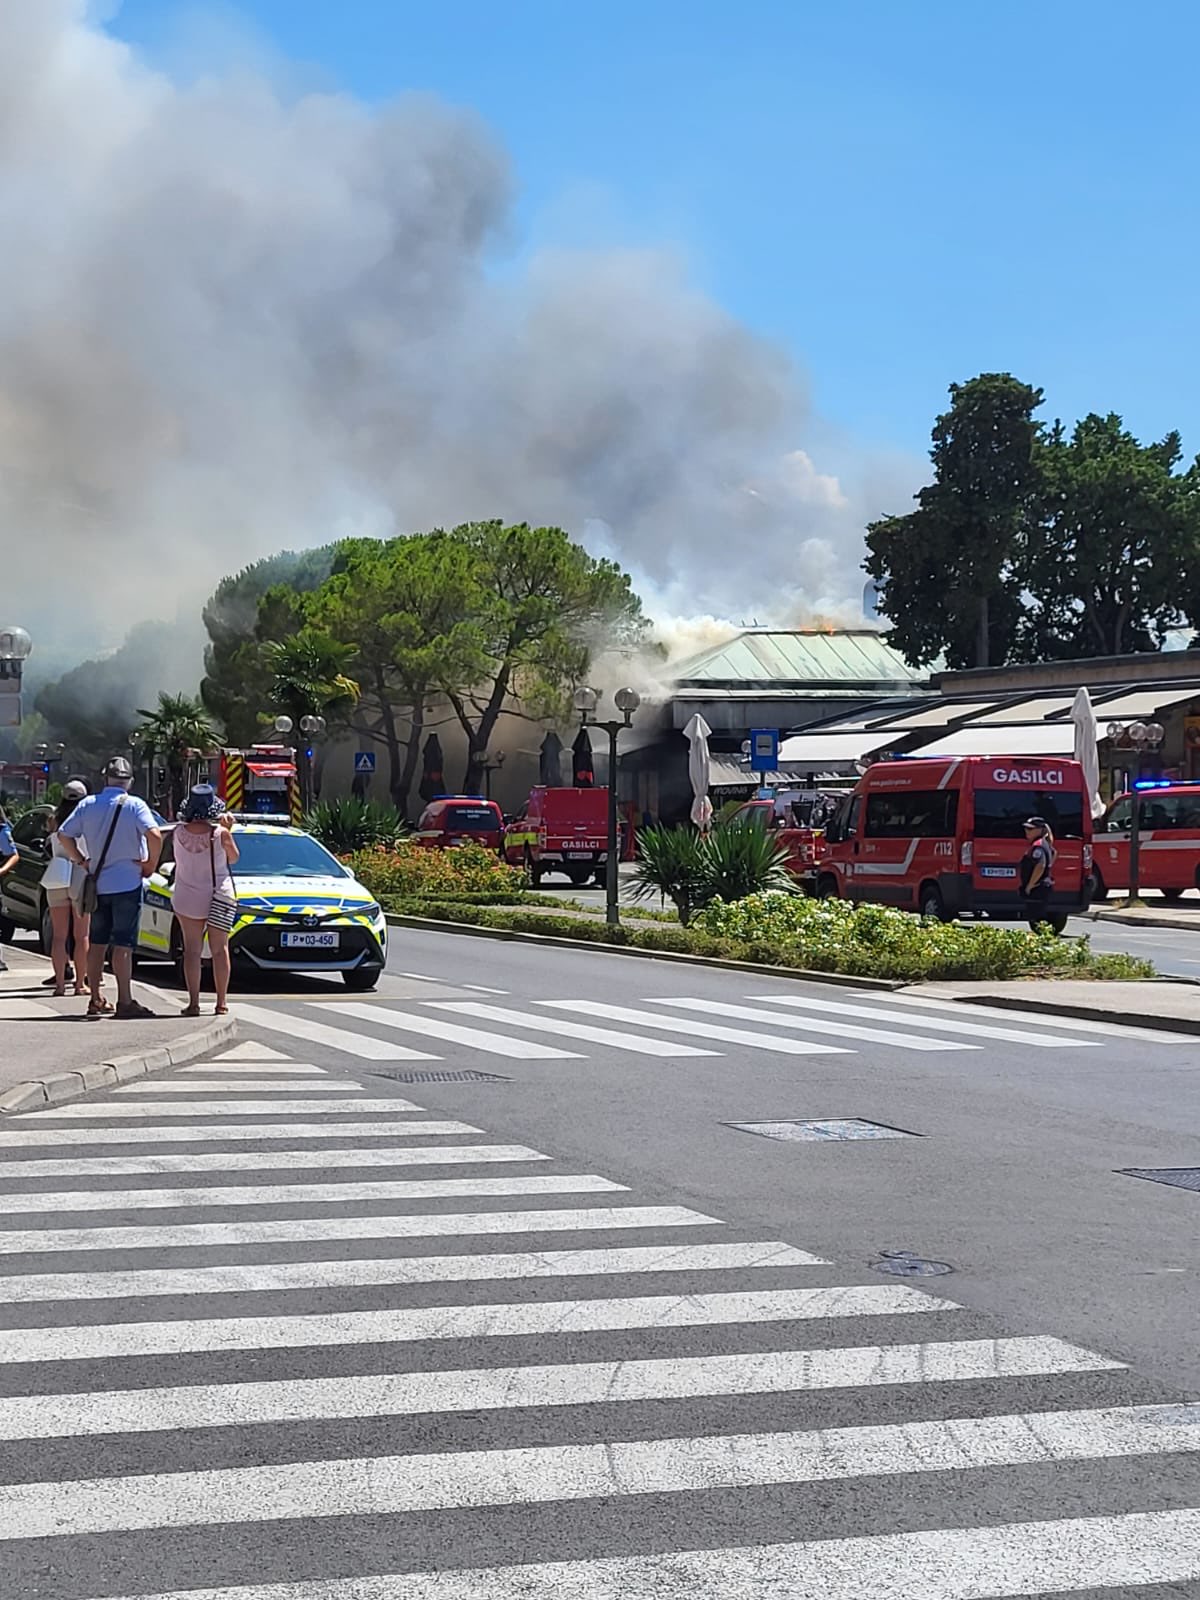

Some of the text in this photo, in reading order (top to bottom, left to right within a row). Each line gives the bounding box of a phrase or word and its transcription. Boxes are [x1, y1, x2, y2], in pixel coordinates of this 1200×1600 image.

[992, 768, 1063, 785] GASILCI
[561, 840, 600, 849] GASILCI
[939, 842, 953, 855] 112
[305, 935, 334, 945] 03-450
